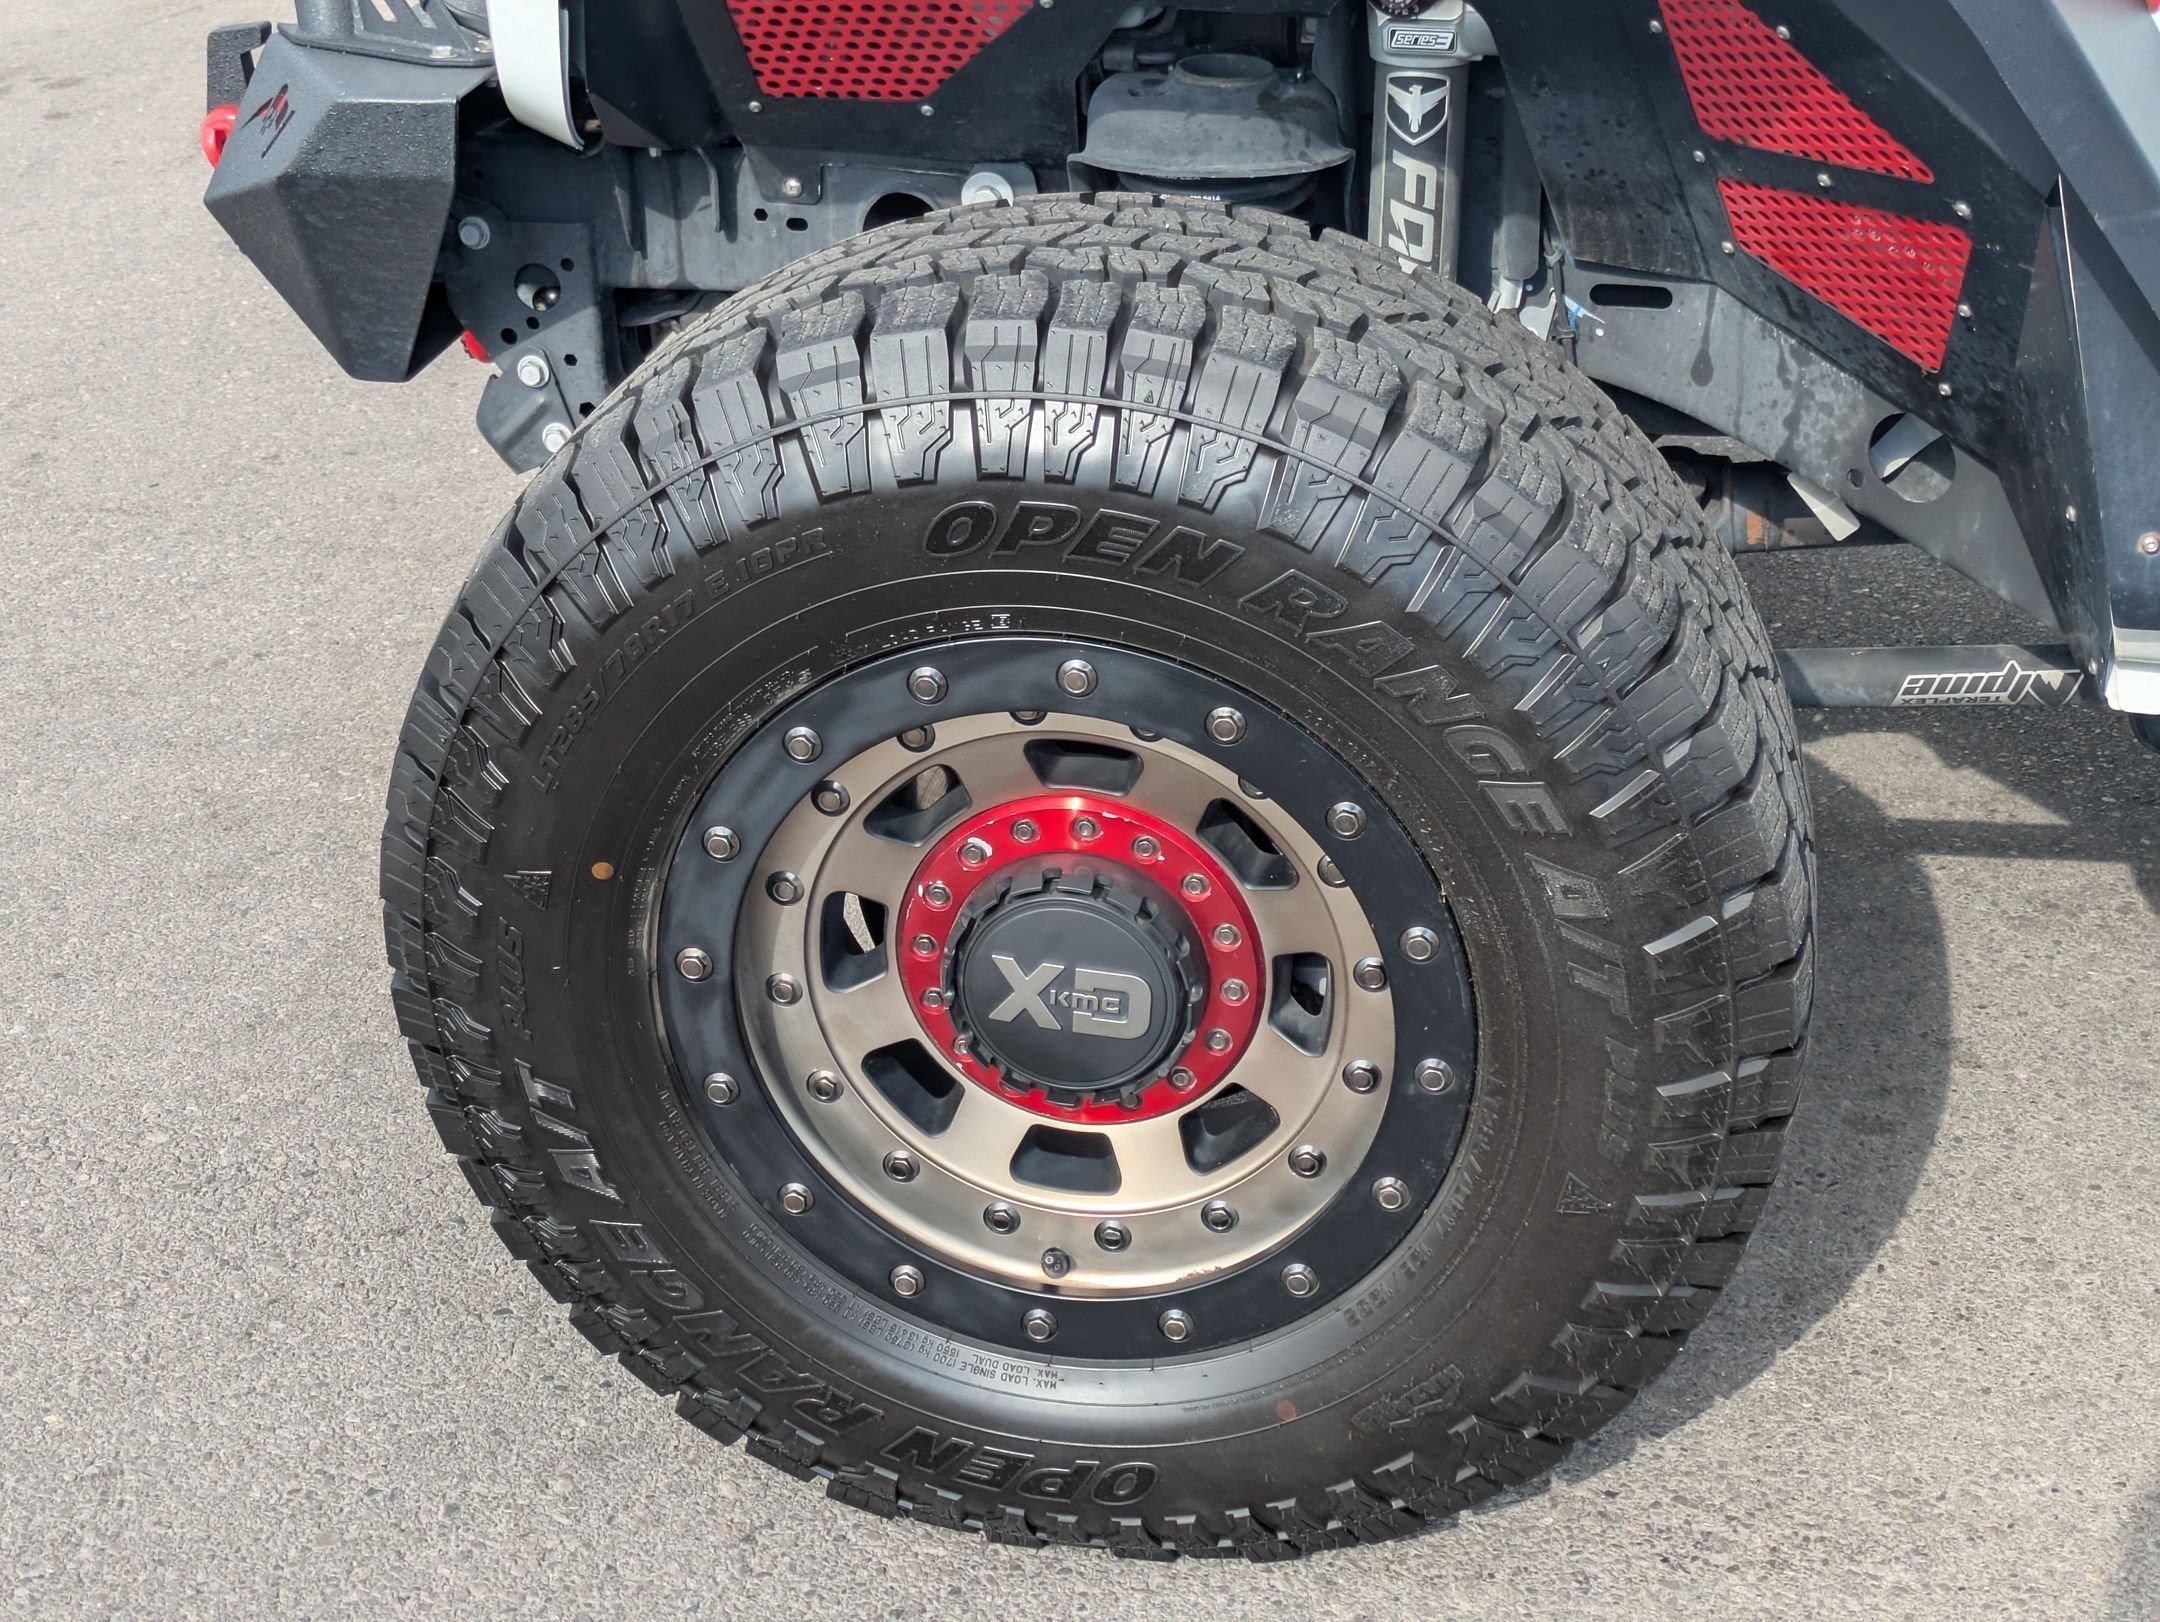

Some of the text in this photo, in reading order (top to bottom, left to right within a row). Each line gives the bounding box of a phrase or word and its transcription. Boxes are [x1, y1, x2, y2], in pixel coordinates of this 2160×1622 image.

[924, 500, 1247, 587] OPEN
[1238, 568, 1572, 838] RANGE
[1900, 696, 2001, 705] TERAFLEX
[988, 955, 1152, 1039] XD
[1050, 989, 1121, 1014] kmc
[514, 1057, 624, 1206] A/T
[589, 1218, 885, 1435] RANGE
[917, 1346, 930, 1360] kg
[936, 1342, 960, 1358] 1550
[933, 1353, 957, 1368] 1700
[972, 1353, 1000, 1370] DUAL
[1002, 1362, 1031, 1375] LOAD
[959, 1361, 996, 1379] SINGLE
[1000, 1373, 1029, 1386] LOAD
[1033, 1376, 1057, 1390] MAX.
[881, 1425, 1160, 1506] OPEN
